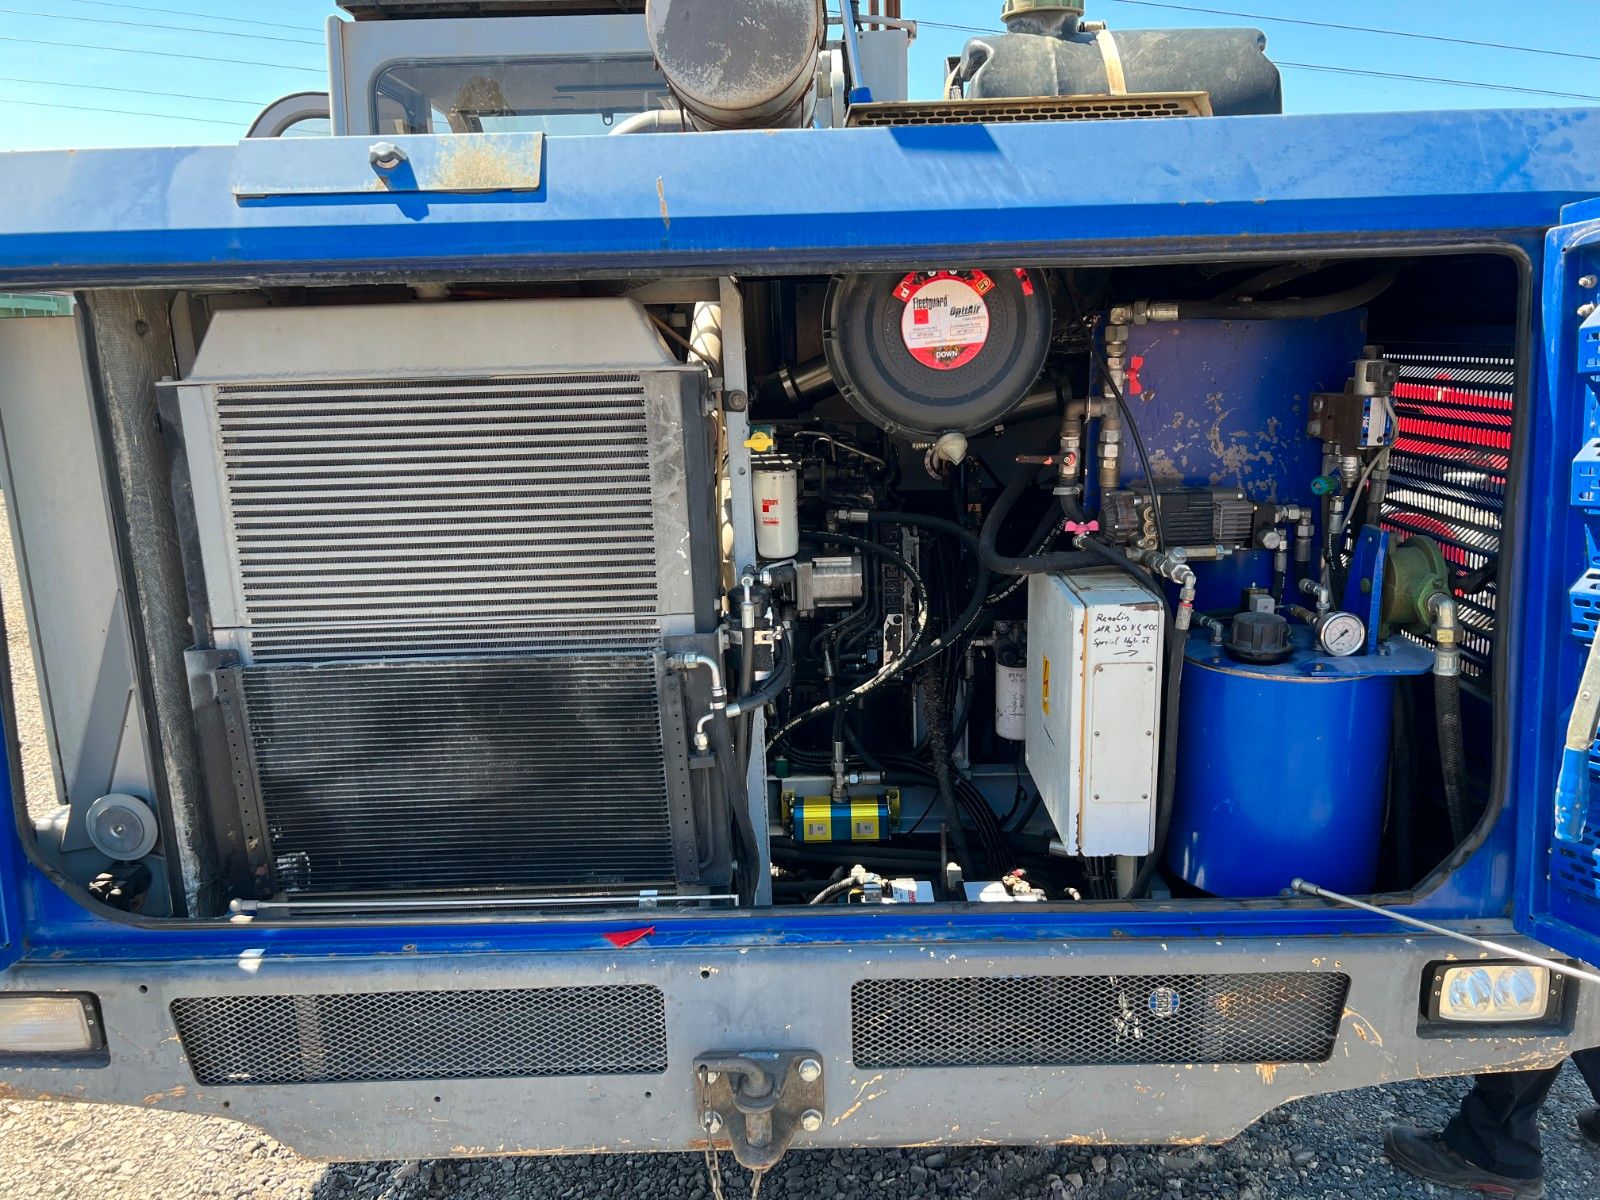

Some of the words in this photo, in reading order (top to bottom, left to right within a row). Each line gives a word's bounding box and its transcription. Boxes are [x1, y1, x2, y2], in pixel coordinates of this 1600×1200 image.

[913, 295, 947, 310] Fleetguard
[936, 350, 957, 359] DOWN
[1115, 624, 1127, 632] 30
